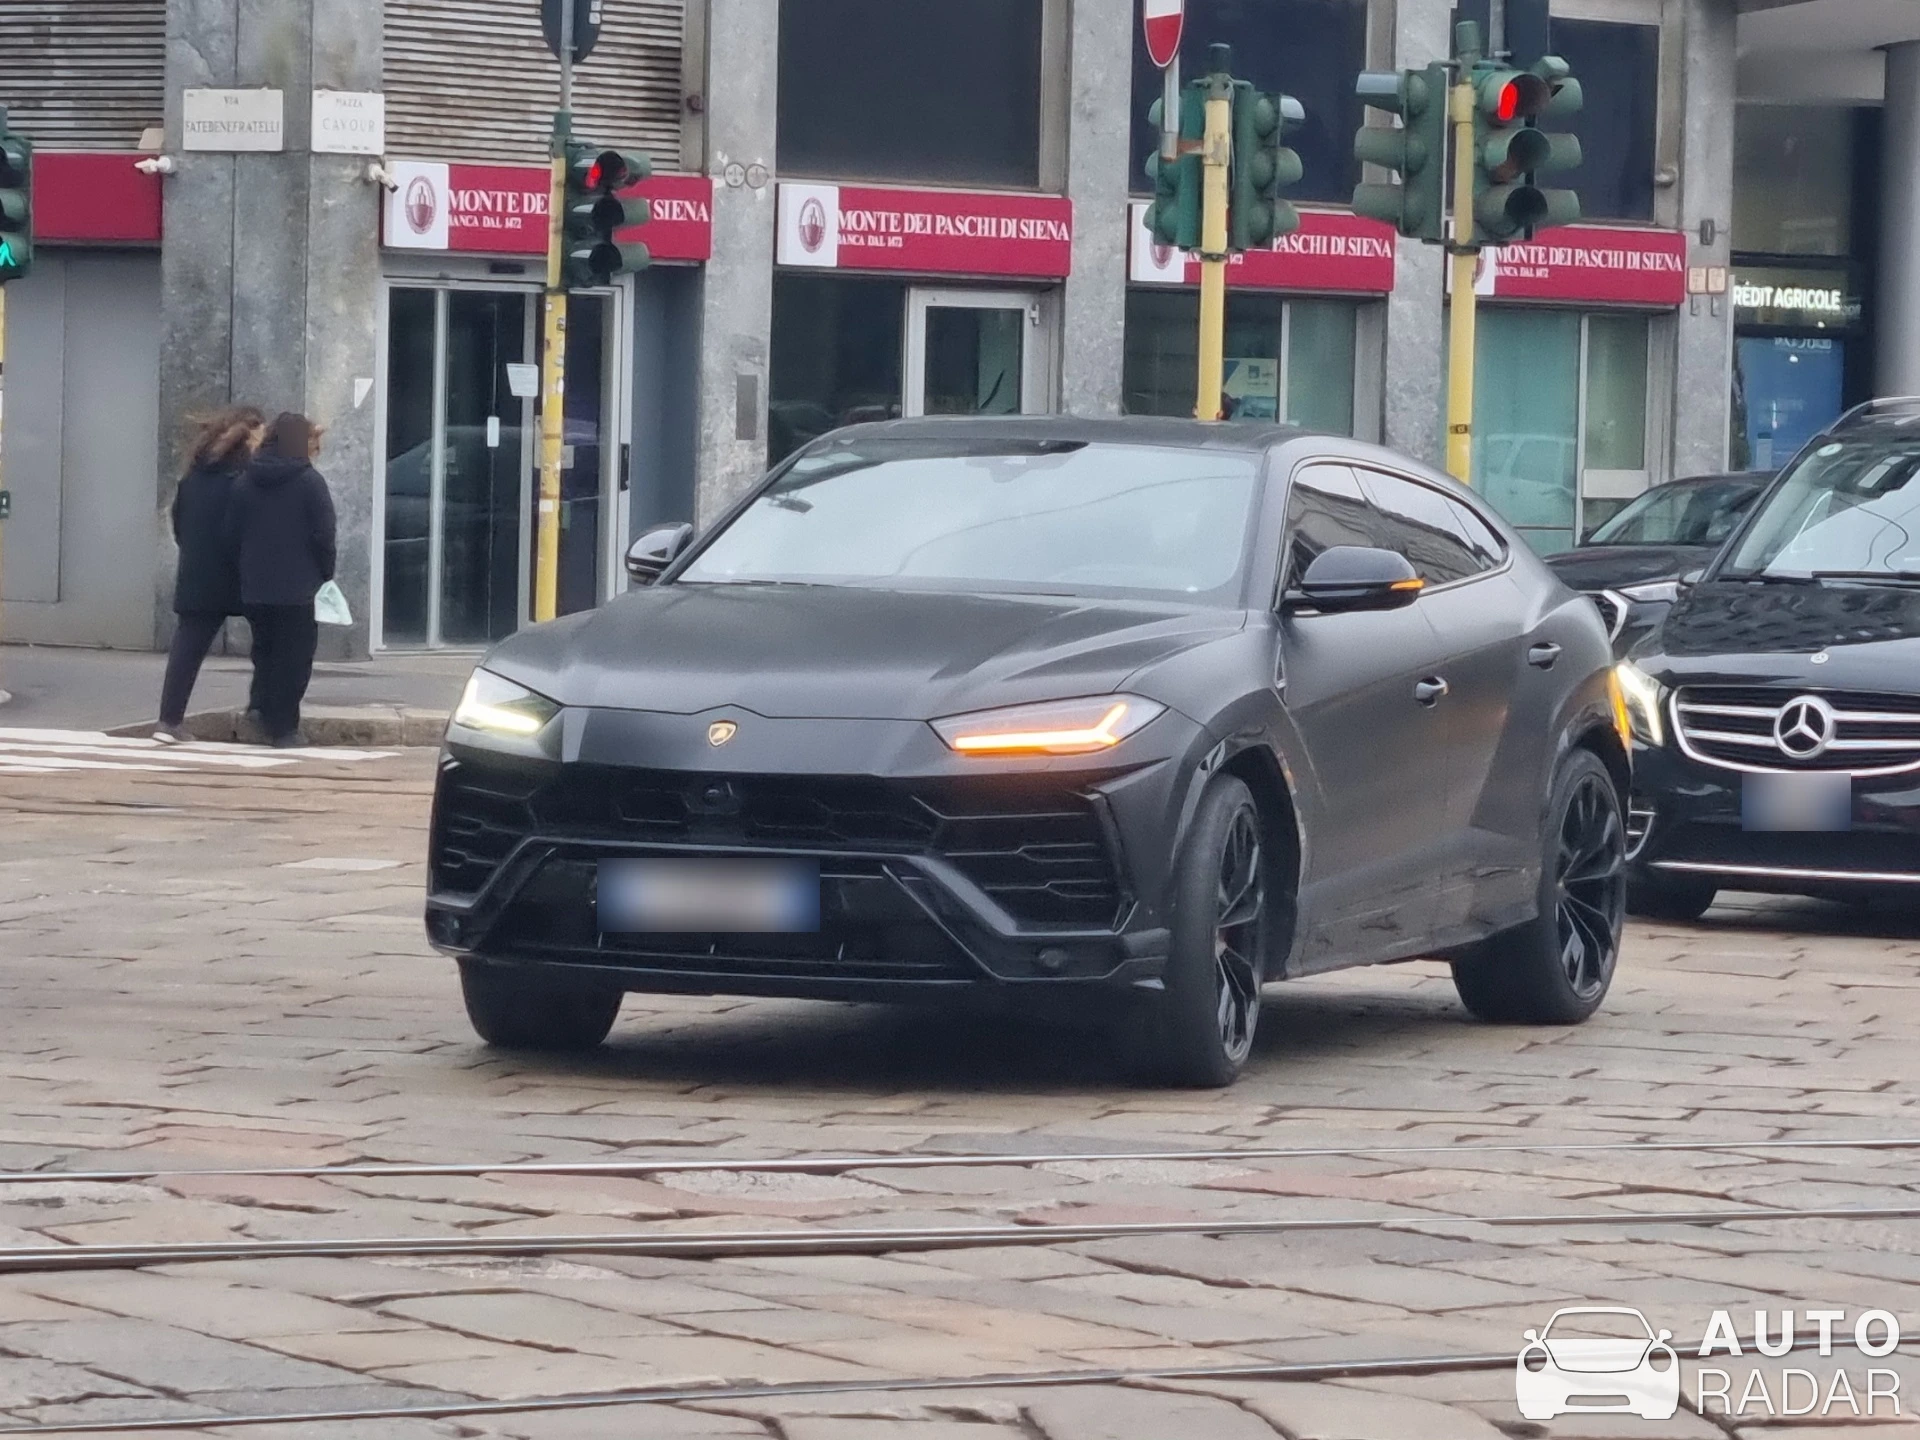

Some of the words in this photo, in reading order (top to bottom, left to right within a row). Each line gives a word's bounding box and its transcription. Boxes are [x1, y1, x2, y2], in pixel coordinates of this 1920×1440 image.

[223, 95, 240, 106] VIA
[335, 98, 364, 108] PIAZZA
[185, 119, 281, 134] FATEBENEFRATELLI
[321, 117, 376, 133] CAVOUR
[448, 189, 520, 214] MONTE
[653, 199, 709, 222] SIENA
[482, 215, 502, 228] DAL
[838, 210, 902, 232] MONTE
[904, 213, 932, 234] DEI
[935, 214, 997, 237] PASCHI
[1000, 217, 1017, 238] DI
[1019, 217, 1070, 241] SIENA
[867, 234, 886, 247] DAL
[1272, 233, 1327, 255] PASCHI
[1330, 235, 1347, 256] DI
[1348, 236, 1392, 258] SIENA
[1495, 244, 1549, 265] MONTE
[1549, 247, 1573, 266] DEI
[1575, 248, 1624, 269] PASCHI
[1626, 251, 1640, 269] DI
[1641, 252, 1683, 272] SIENA
[1733, 281, 1774, 307] RÉDIT
[1773, 286, 1842, 310] AGRICOLE
